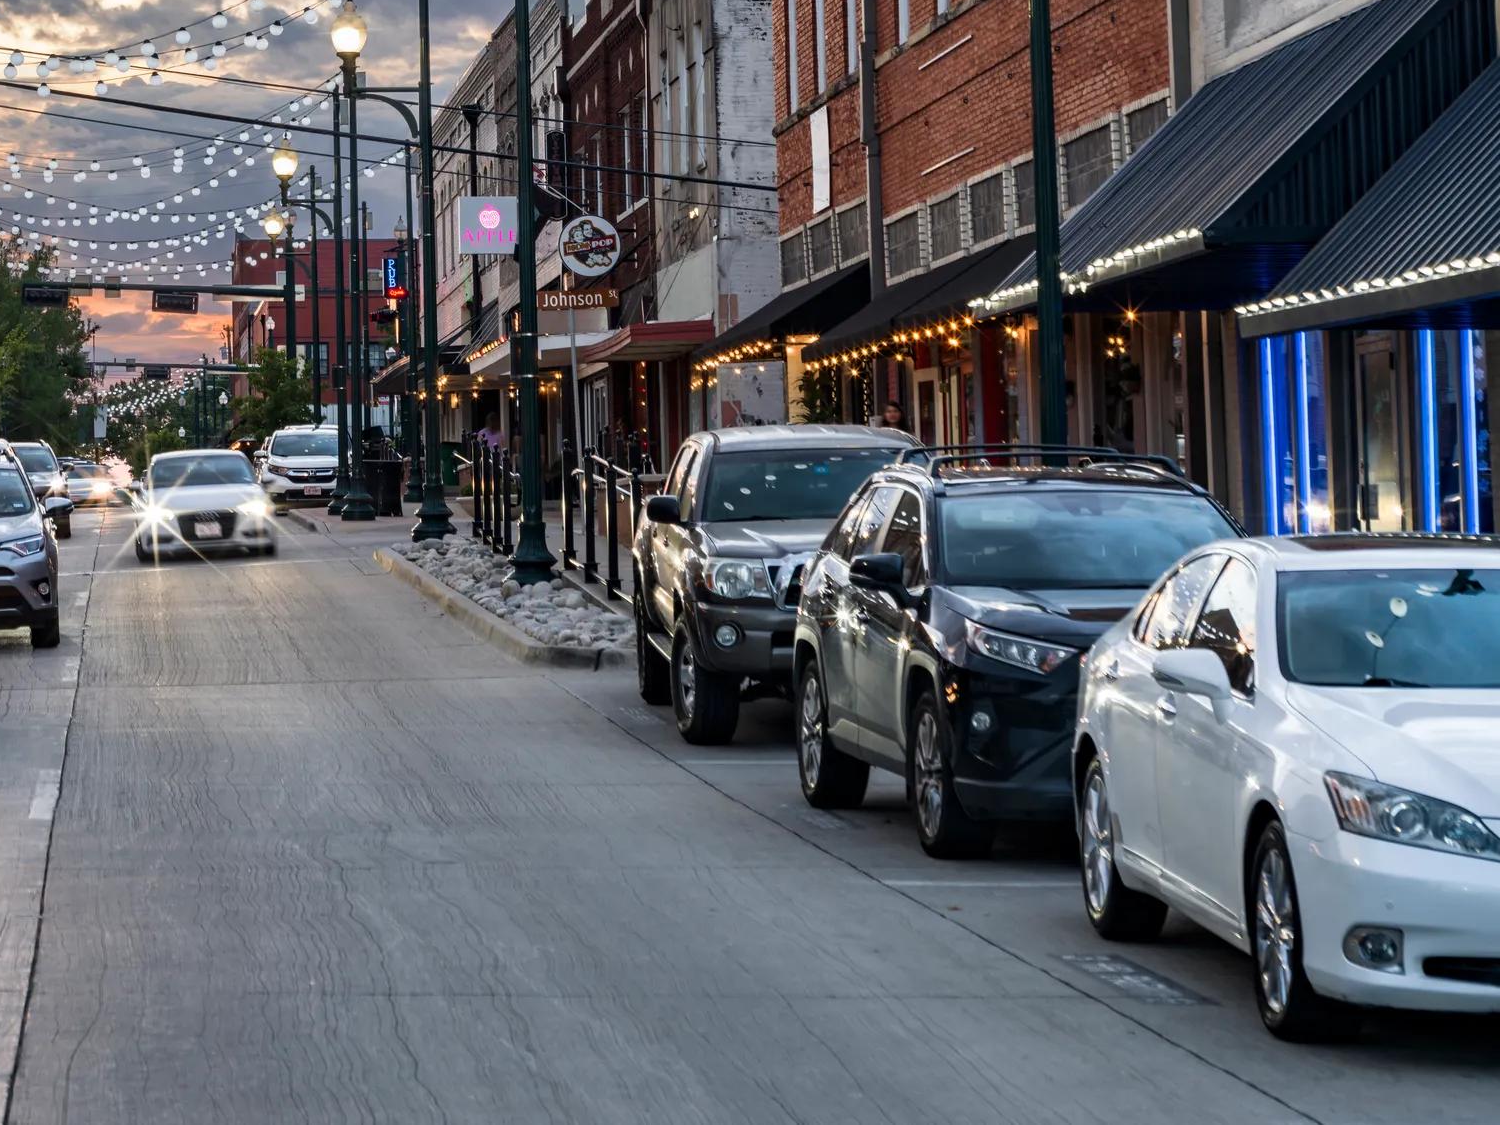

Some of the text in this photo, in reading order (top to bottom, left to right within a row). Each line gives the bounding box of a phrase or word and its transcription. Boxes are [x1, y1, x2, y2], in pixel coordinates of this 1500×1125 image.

[463, 229, 516, 243] APPLE
[591, 239, 614, 249] POP
[388, 259, 396, 288] PUB
[543, 292, 603, 307] Johnson
